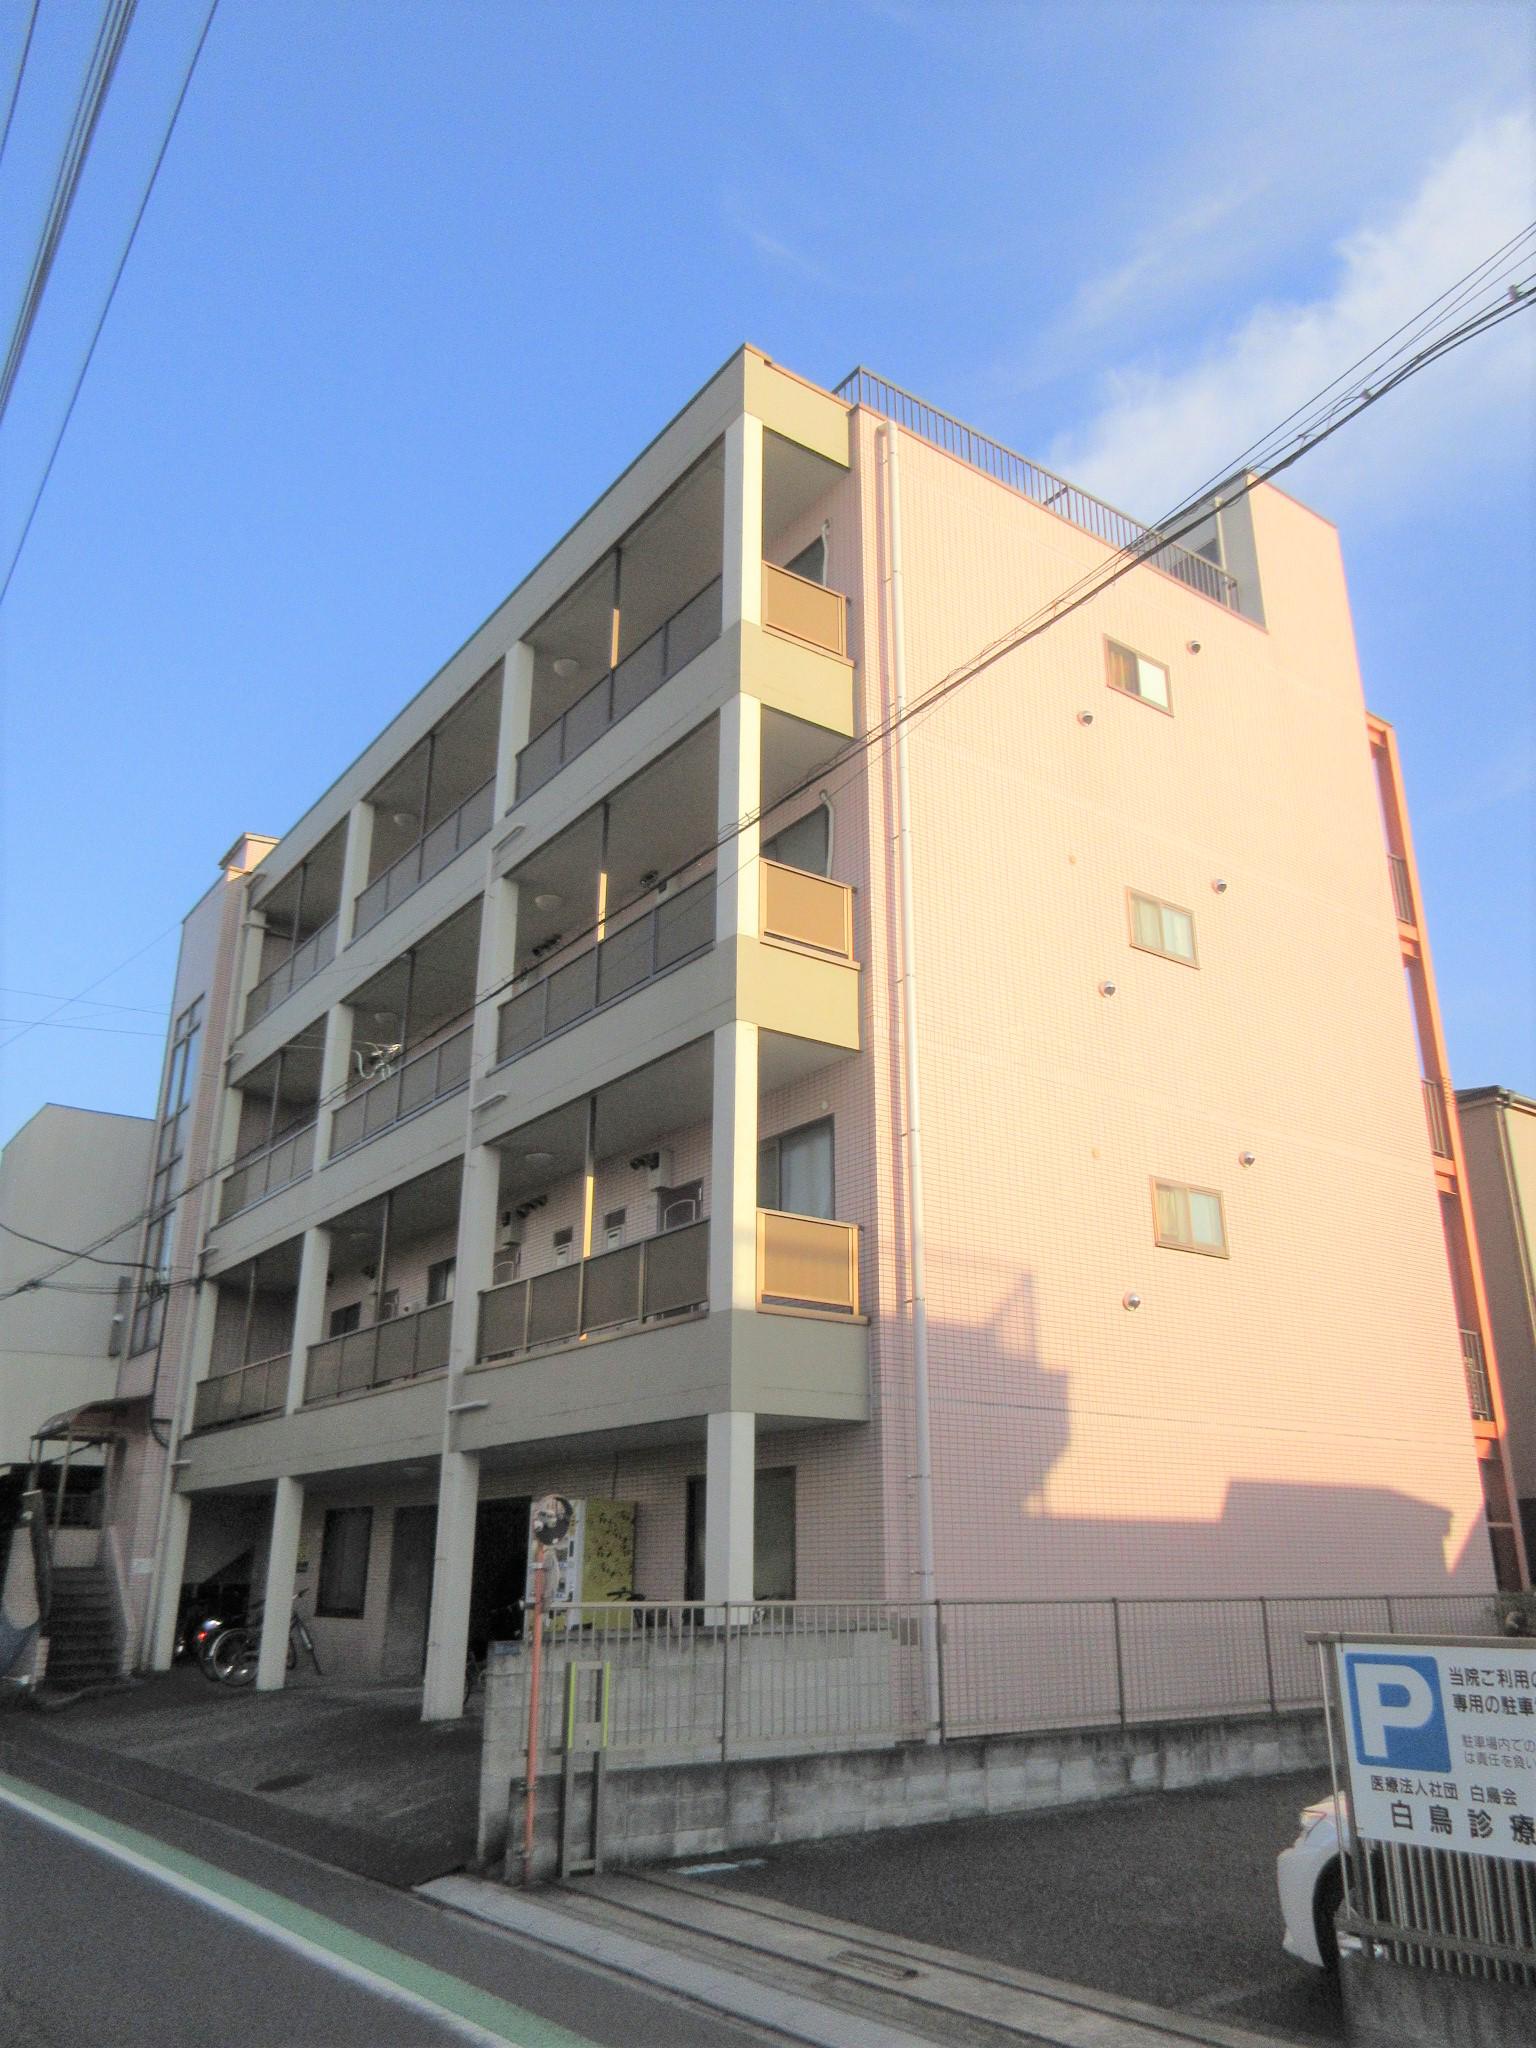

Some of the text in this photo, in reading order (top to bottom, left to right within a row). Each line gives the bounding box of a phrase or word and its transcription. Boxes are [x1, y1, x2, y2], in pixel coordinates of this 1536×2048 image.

[1354, 1662, 1433, 1759] P
[1452, 1693, 1536, 1716] 専用の駐車
[1370, 1774, 1459, 1800] 医療法人社団
